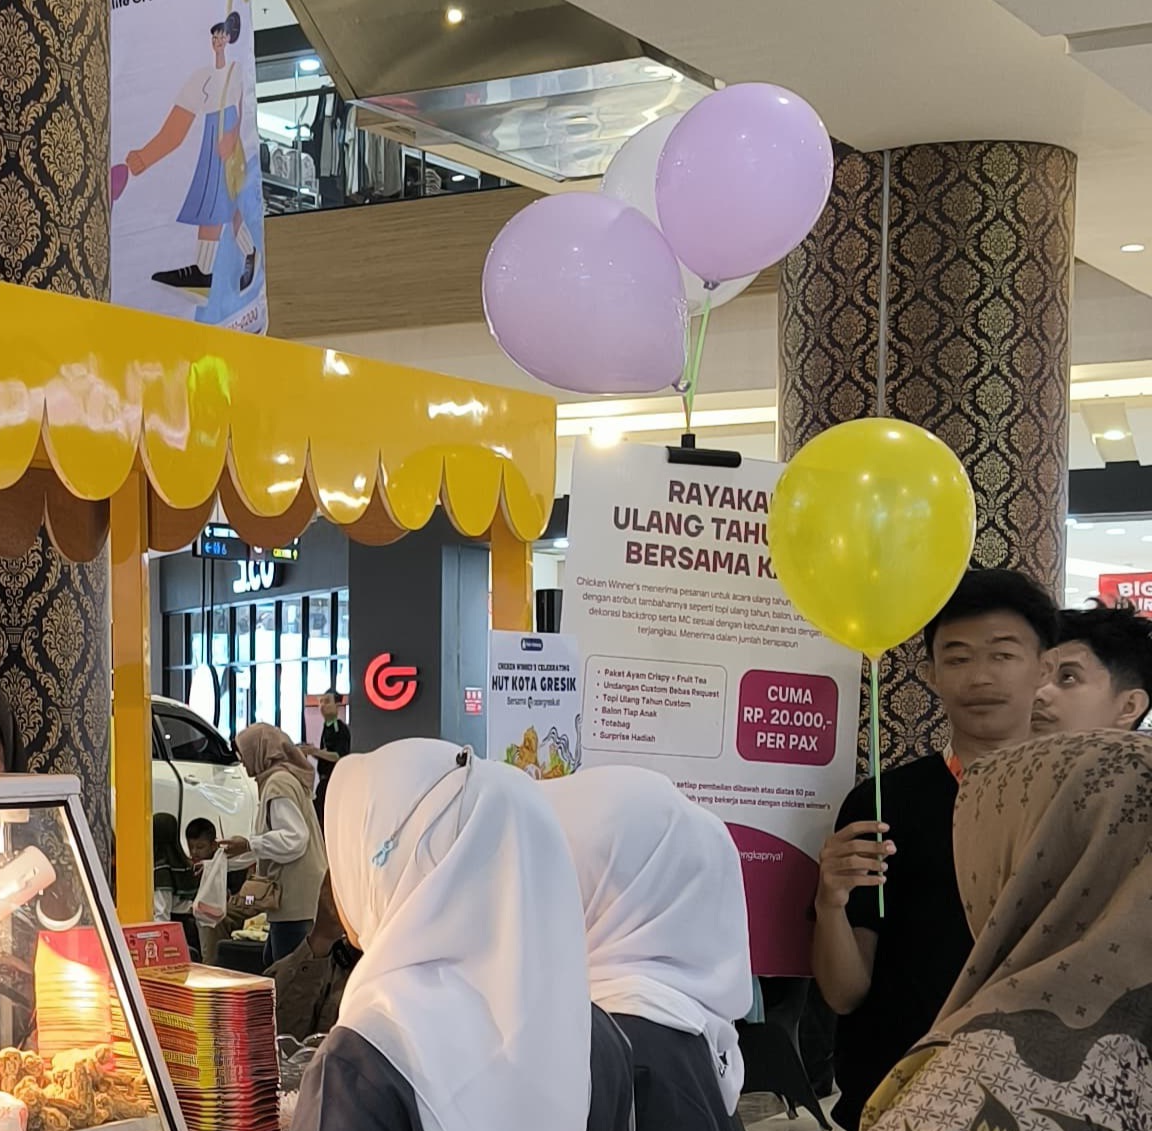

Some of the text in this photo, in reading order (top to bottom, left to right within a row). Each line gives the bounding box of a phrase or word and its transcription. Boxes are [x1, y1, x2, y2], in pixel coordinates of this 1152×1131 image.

[668, 479, 774, 514] RAYAKA
[613, 506, 705, 538] ULANG
[625, 540, 778, 580] BERSAMA K
[576, 576, 792, 606] Chicken Winner's menerima pesanan untuk acara ulang tahun
[582, 591, 611, 604] dengan
[612, 596, 637, 605] atribut
[638, 598, 688, 611] tambahannya
[688, 602, 714, 613] seperti
[714, 604, 729, 614] topi
[729, 607, 750, 618] ulang
[588, 607, 621, 618] dekorasi
[622, 610, 658, 622] backdrop
[658, 614, 678, 623] serta
[678, 615, 692, 624] MC
[692, 617, 715, 626] sesuai
[715, 619, 743, 631] dengan
[743, 622, 781, 633] kebutuhan
[780, 625, 797, 634] anda
[679, 629, 716, 641] Menerima
[715, 632, 738, 643] dalam
[738, 635, 762, 645] jumlah
[762, 637, 799, 649] berapapun
[492, 676, 576, 692] HUT KOTA GRESIK
[604, 668, 626, 679] Paket
[626, 671, 647, 681] Ayam
[647, 672, 670, 683] Crispy
[676, 675, 694, 684] Fruit
[603, 681, 640, 693] Undangan
[640, 684, 668, 694] Custom
[691, 688, 720, 699] Request
[767, 685, 813, 704] CUMA
[603, 694, 691, 708] Topi Ulang Tahun Custom
[601, 706, 657, 718] Balon Tiap Anak
[743, 706, 833, 731] RP. 20.000,-
[601, 718, 631, 730] Totebag
[599, 731, 656, 743] Surprise Hadiah
[756, 731, 819, 752] PER PAX
[676, 781, 697, 791] setiap
[698, 783, 732, 793] pembelian
[733, 784, 760, 794] dibawah
[760, 787, 775, 795] atau
[776, 787, 795, 796] diatas
[804, 790, 816, 798] pax
[697, 796, 713, 805] yang
[714, 796, 739, 806] bekerja
[739, 798, 757, 806] sama
[757, 799, 781, 809] dengan
[781, 801, 805, 810] chicken
